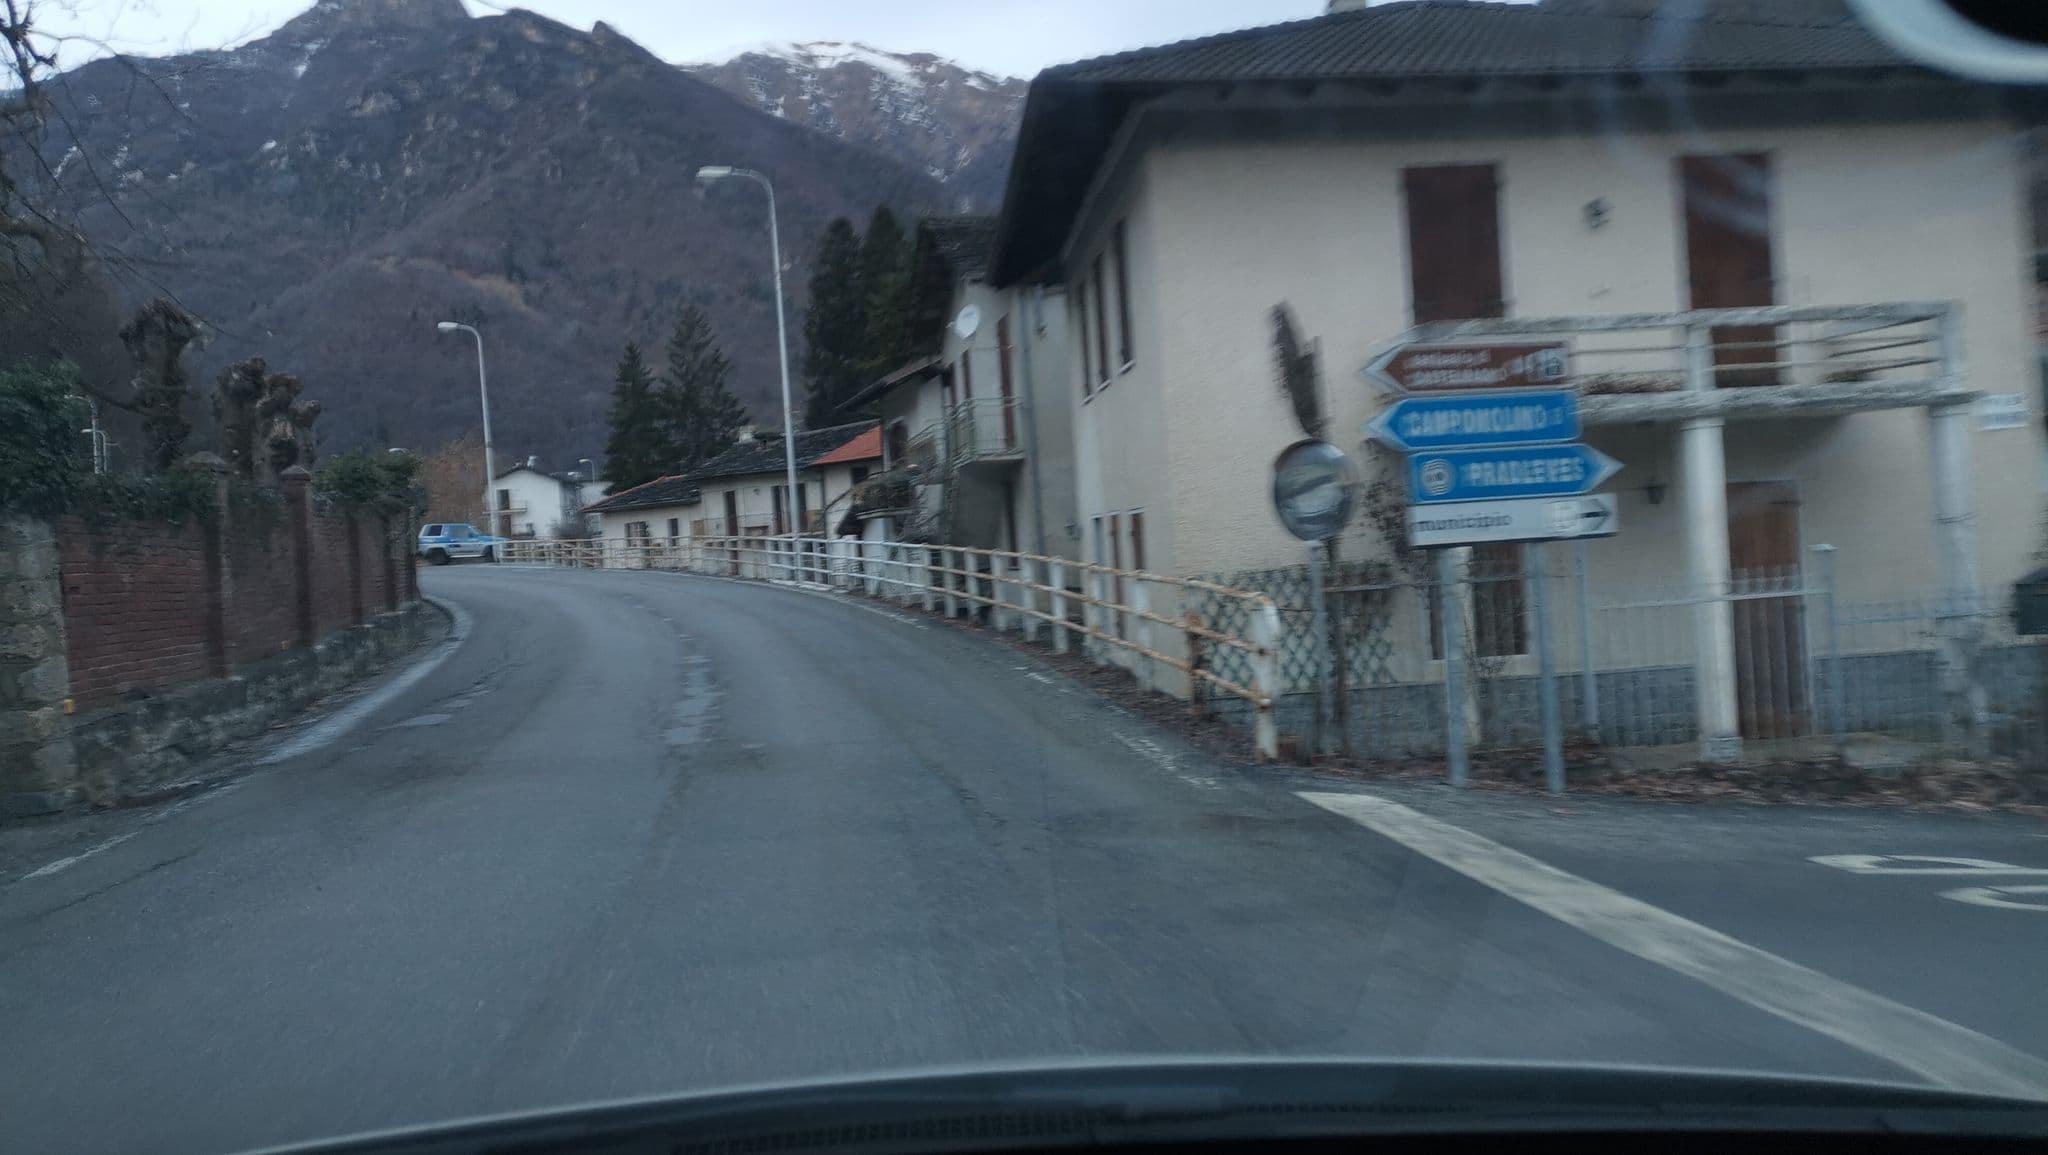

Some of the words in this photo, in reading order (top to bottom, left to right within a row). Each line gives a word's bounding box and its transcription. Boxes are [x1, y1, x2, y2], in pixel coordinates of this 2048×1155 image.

[1403, 404, 1547, 436] CAMPOMOLINO
[1464, 457, 1584, 486] PRADLEVES
[1413, 512, 1512, 531] municipio
